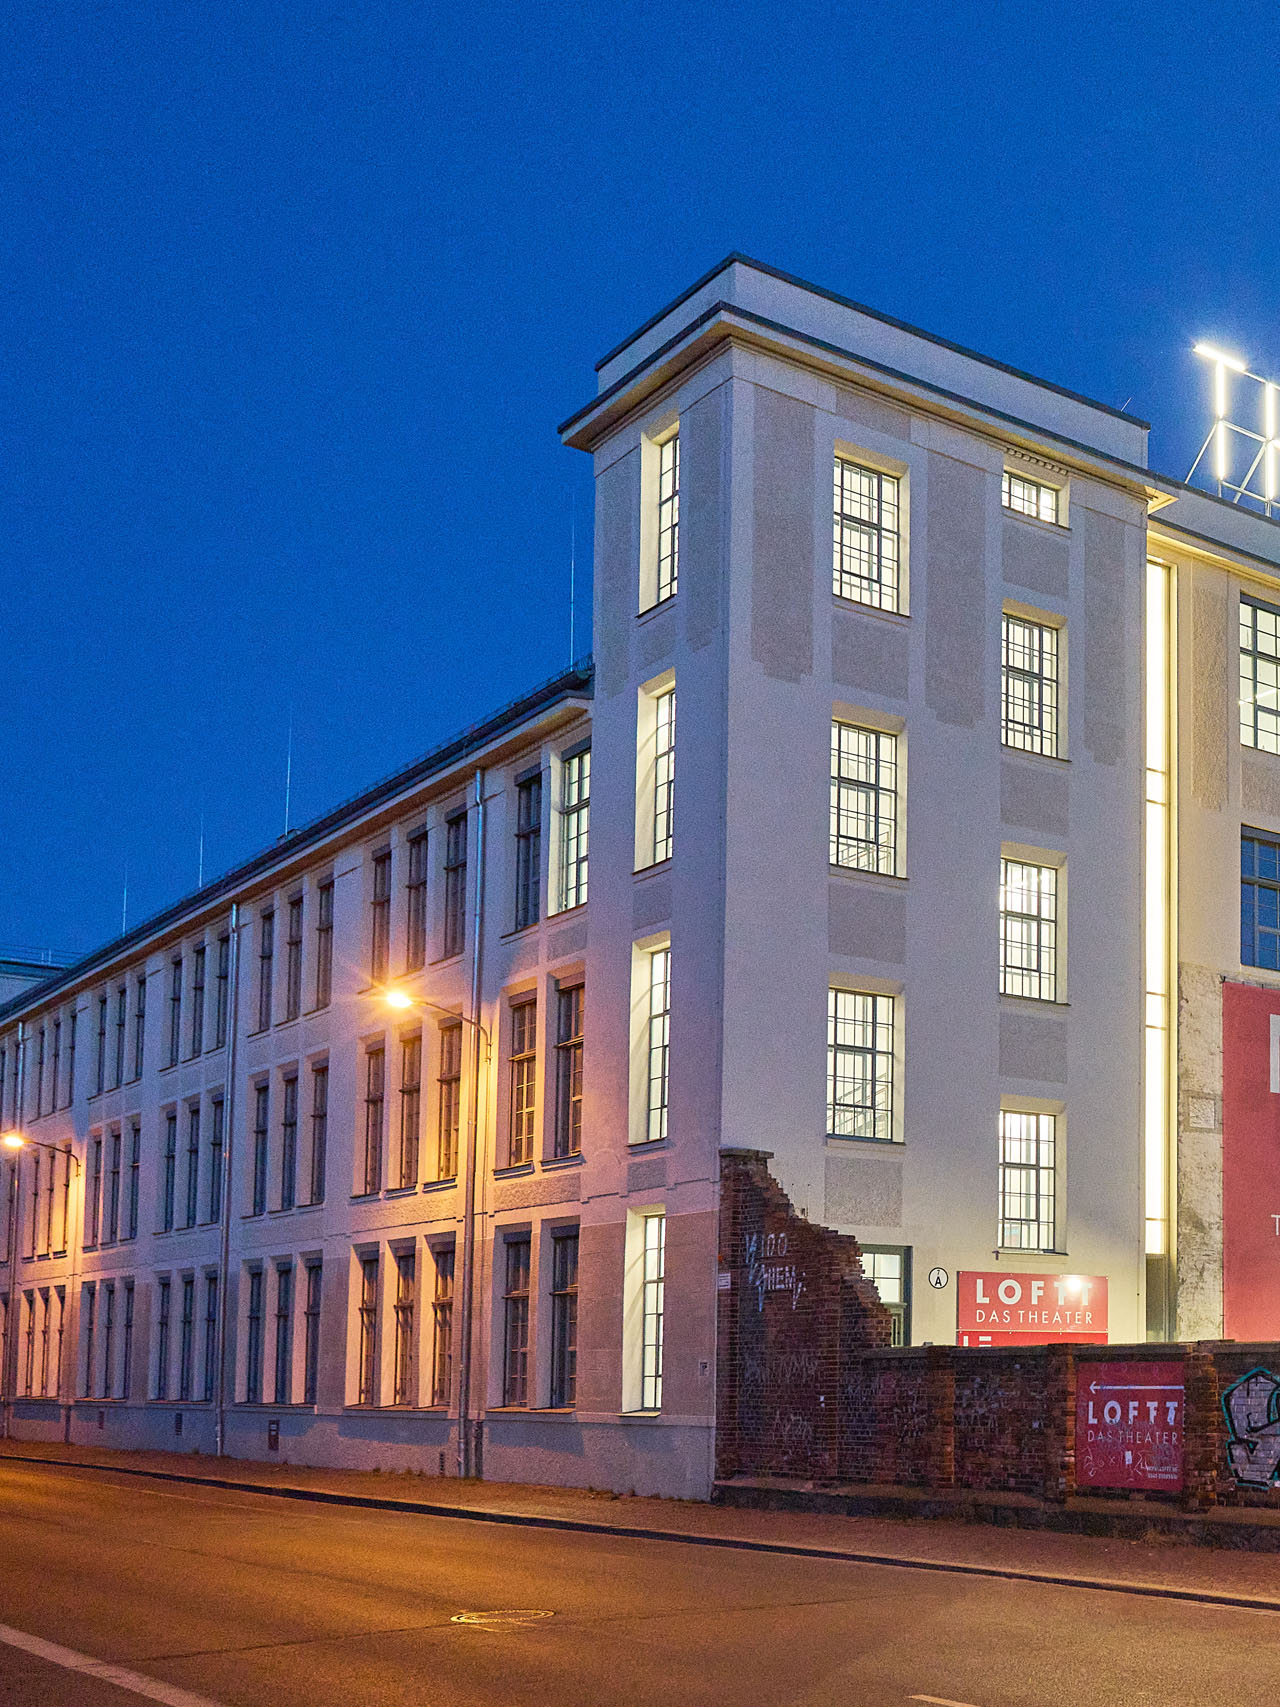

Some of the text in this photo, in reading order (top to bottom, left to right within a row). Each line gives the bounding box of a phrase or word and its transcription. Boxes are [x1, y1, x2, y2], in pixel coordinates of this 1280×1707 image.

[976, 1309, 1093, 1324] DAS THEATER
[1118, 1431, 1179, 1445] THEATER
